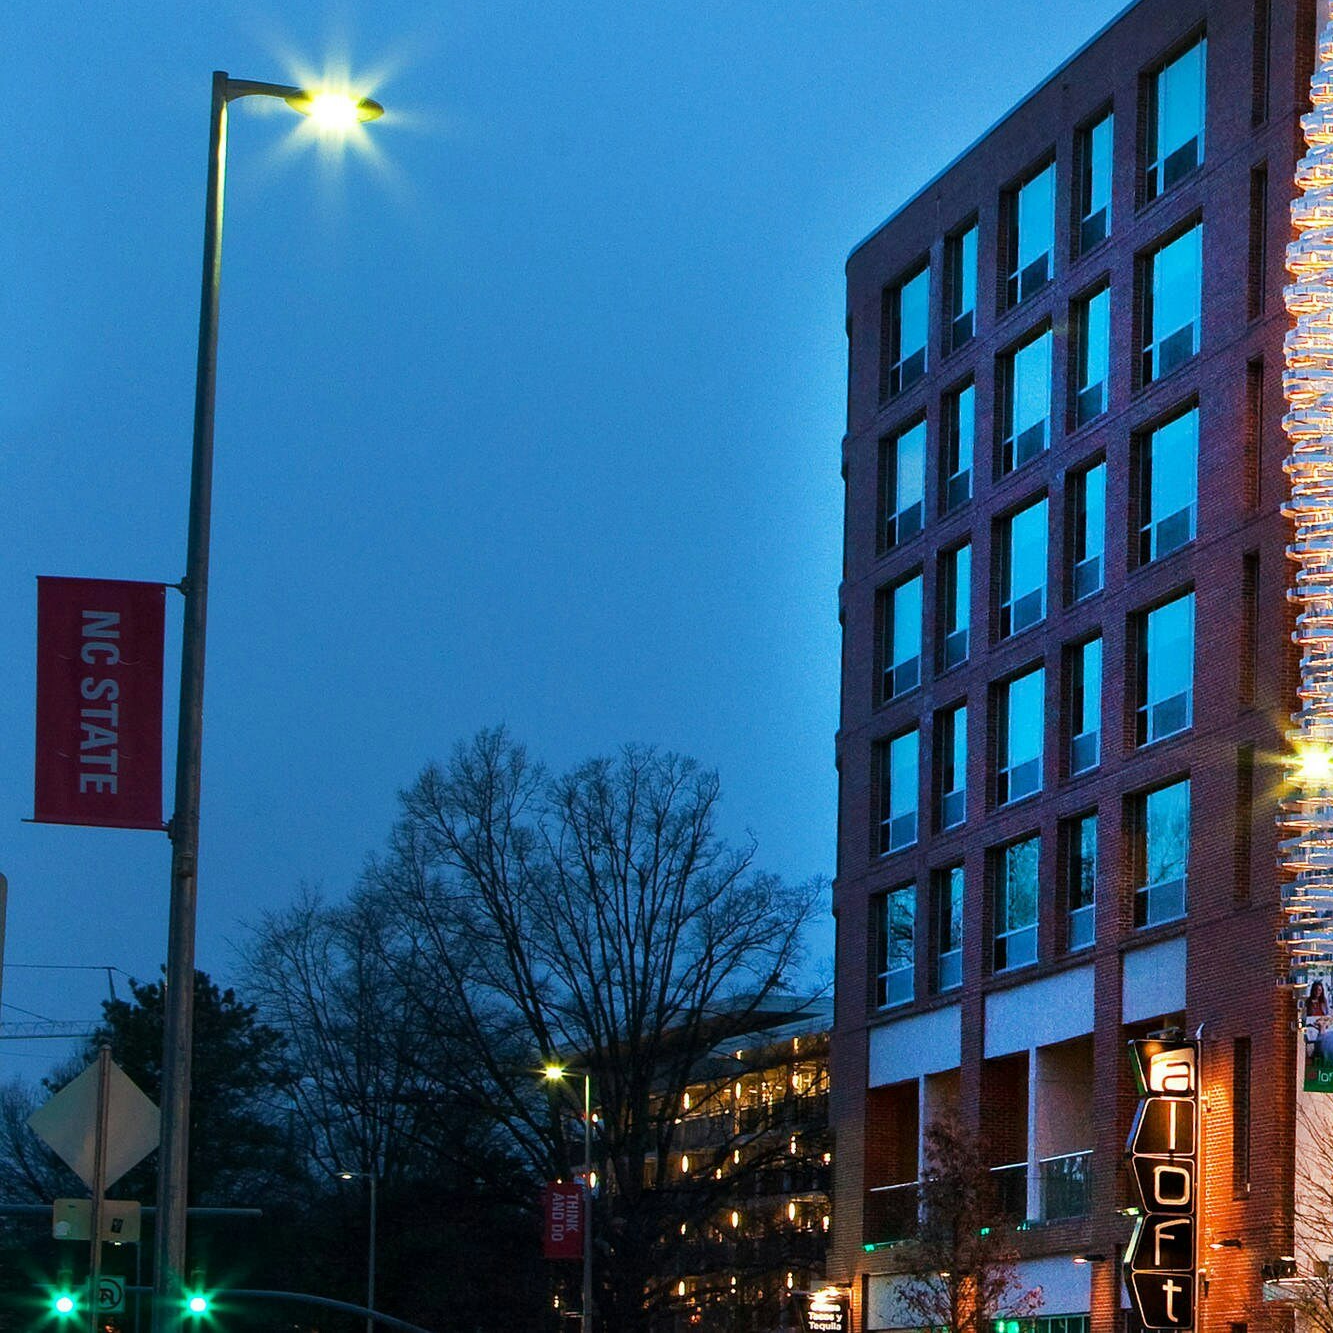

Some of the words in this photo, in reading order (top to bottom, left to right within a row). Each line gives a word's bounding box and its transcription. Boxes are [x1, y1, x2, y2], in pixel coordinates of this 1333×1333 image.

[81, 610, 120, 666] NC
[79, 677, 120, 795] STATE
[1150, 1048, 1196, 1323] aloft
[552, 1192, 566, 1220] AND
[566, 1193, 579, 1233] THINK
[551, 1224, 564, 1242] DO
[808, 1321, 842, 1332] Tequila
